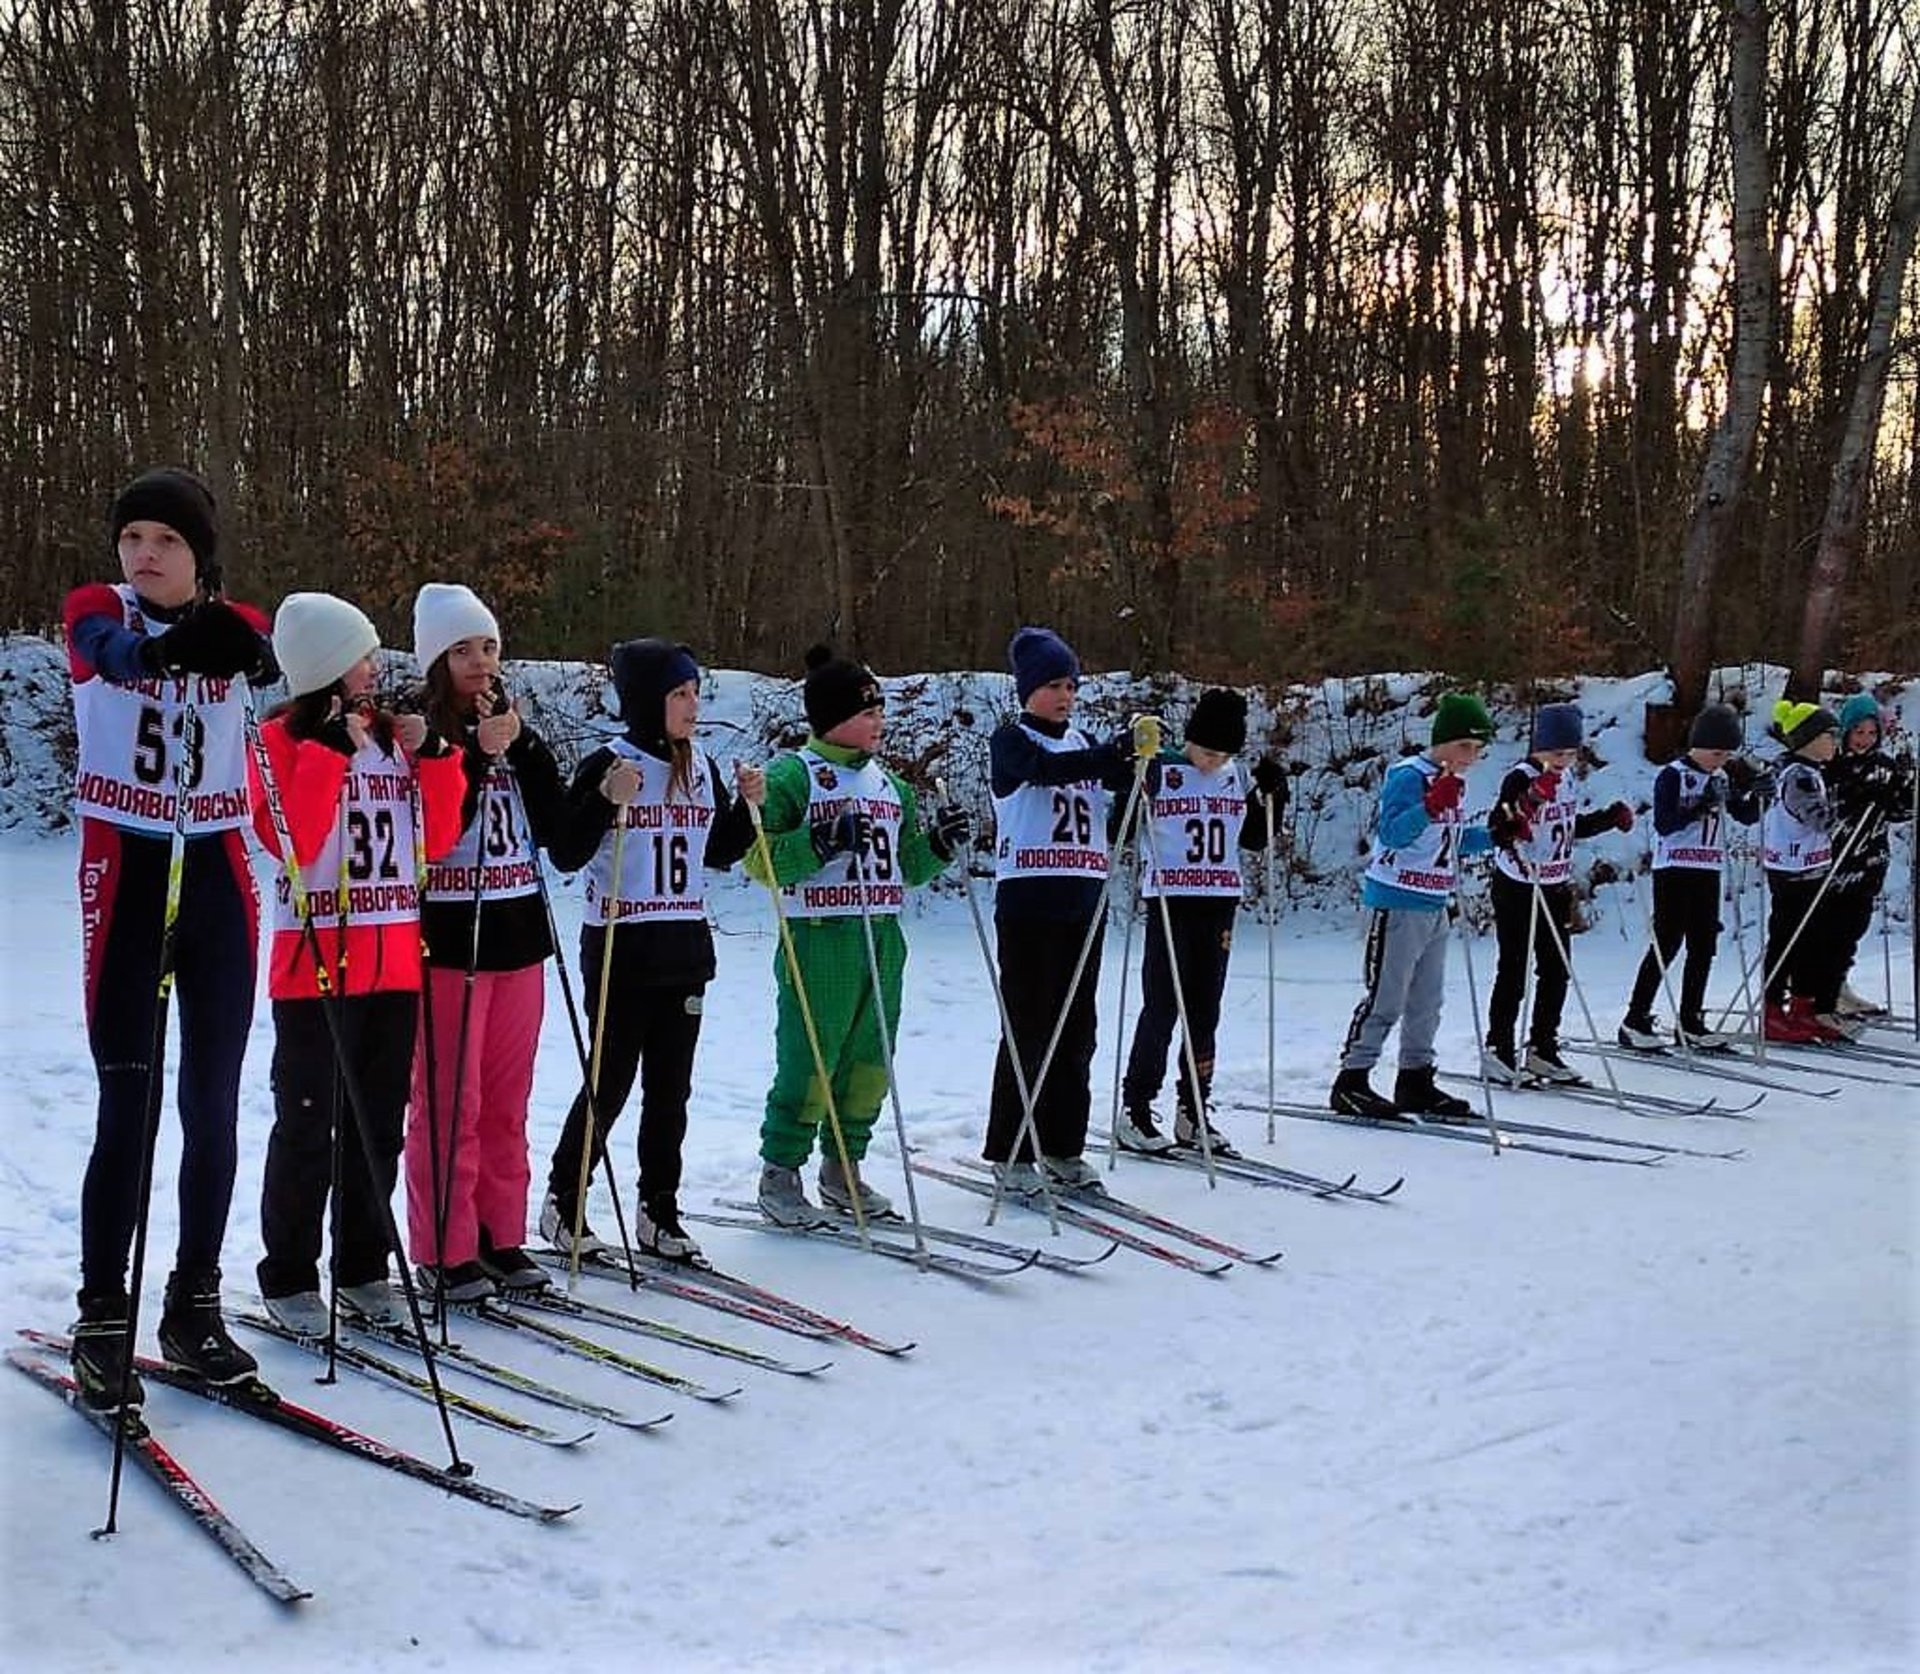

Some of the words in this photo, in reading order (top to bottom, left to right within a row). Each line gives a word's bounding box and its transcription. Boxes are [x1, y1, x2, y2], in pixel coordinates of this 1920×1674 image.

[135, 706, 205, 789] 53
[348, 810, 399, 879] 32
[486, 797, 519, 857] 31
[1051, 791, 1091, 844] 26
[1184, 818, 1225, 864] 30
[653, 834, 688, 896] 16
